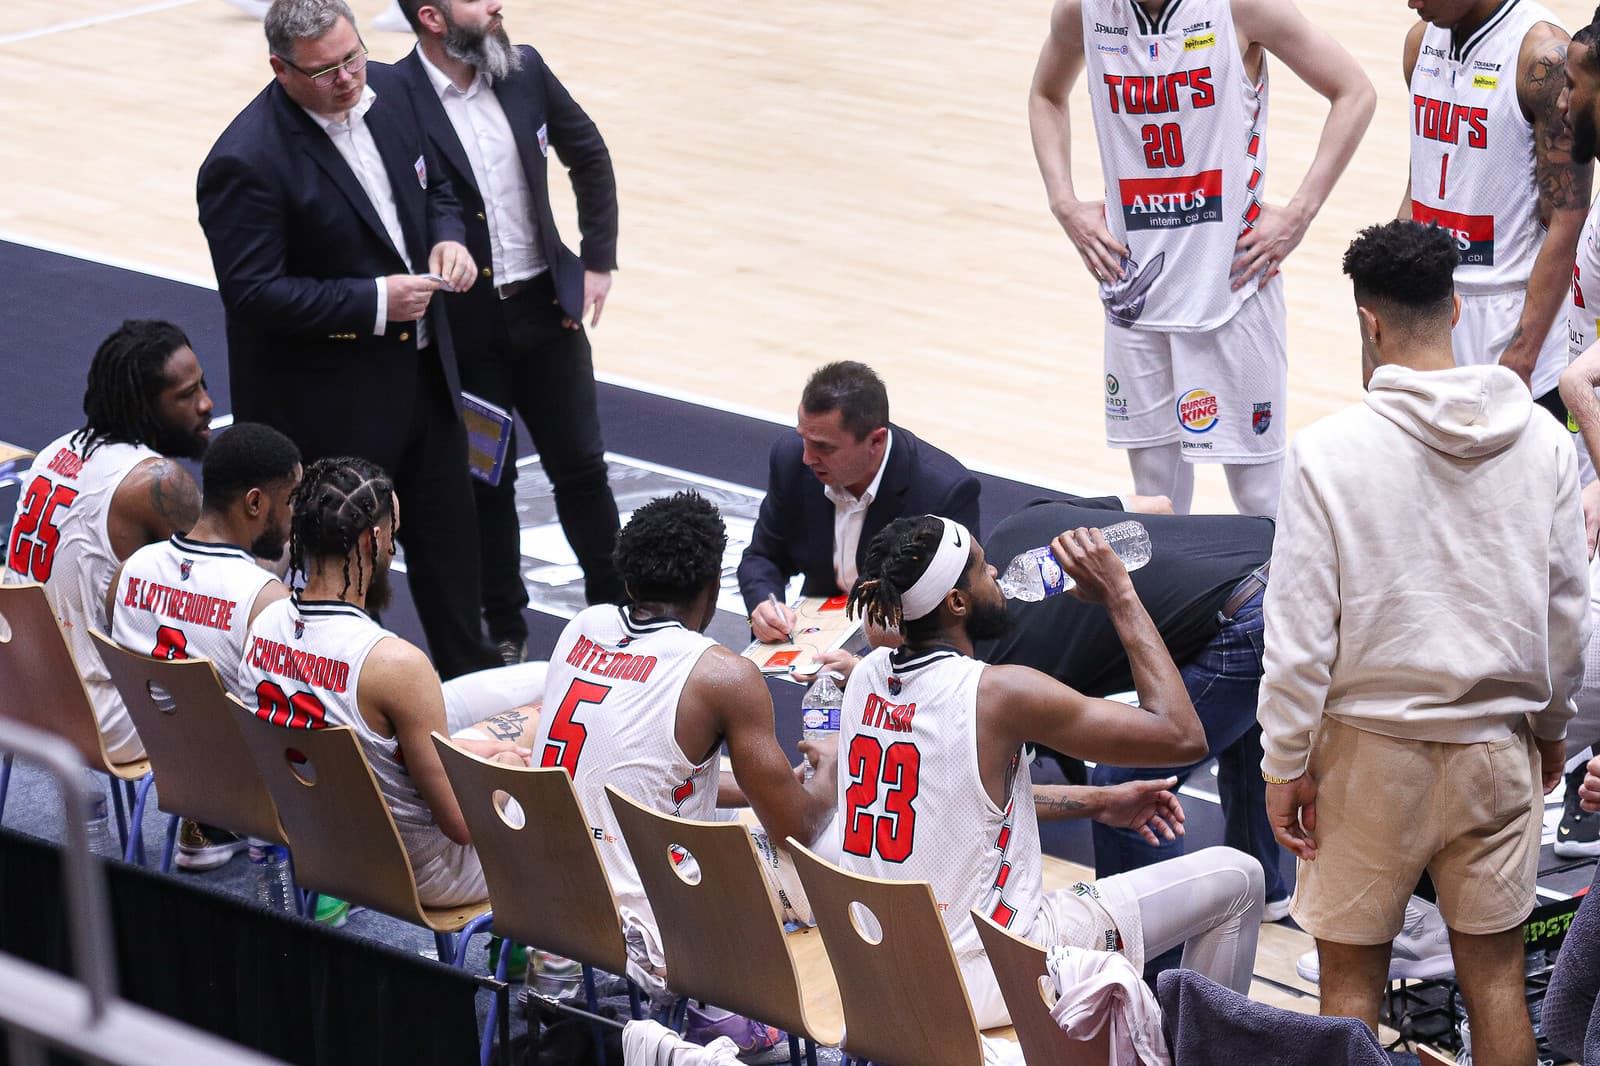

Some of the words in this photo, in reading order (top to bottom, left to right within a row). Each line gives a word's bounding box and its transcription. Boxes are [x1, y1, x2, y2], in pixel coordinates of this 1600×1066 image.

[1141, 122, 1185, 169] 20
[1439, 153, 1449, 200] 1
[1130, 188, 1206, 215] ARTUS
[1149, 217, 1182, 227] interim
[1467, 255, 1483, 263] CDI
[1180, 396, 1217, 413] BURGER
[1182, 404, 1218, 425] KING
[8, 474, 79, 584] 25
[541, 677, 612, 782] 5
[843, 733, 921, 864] 23
